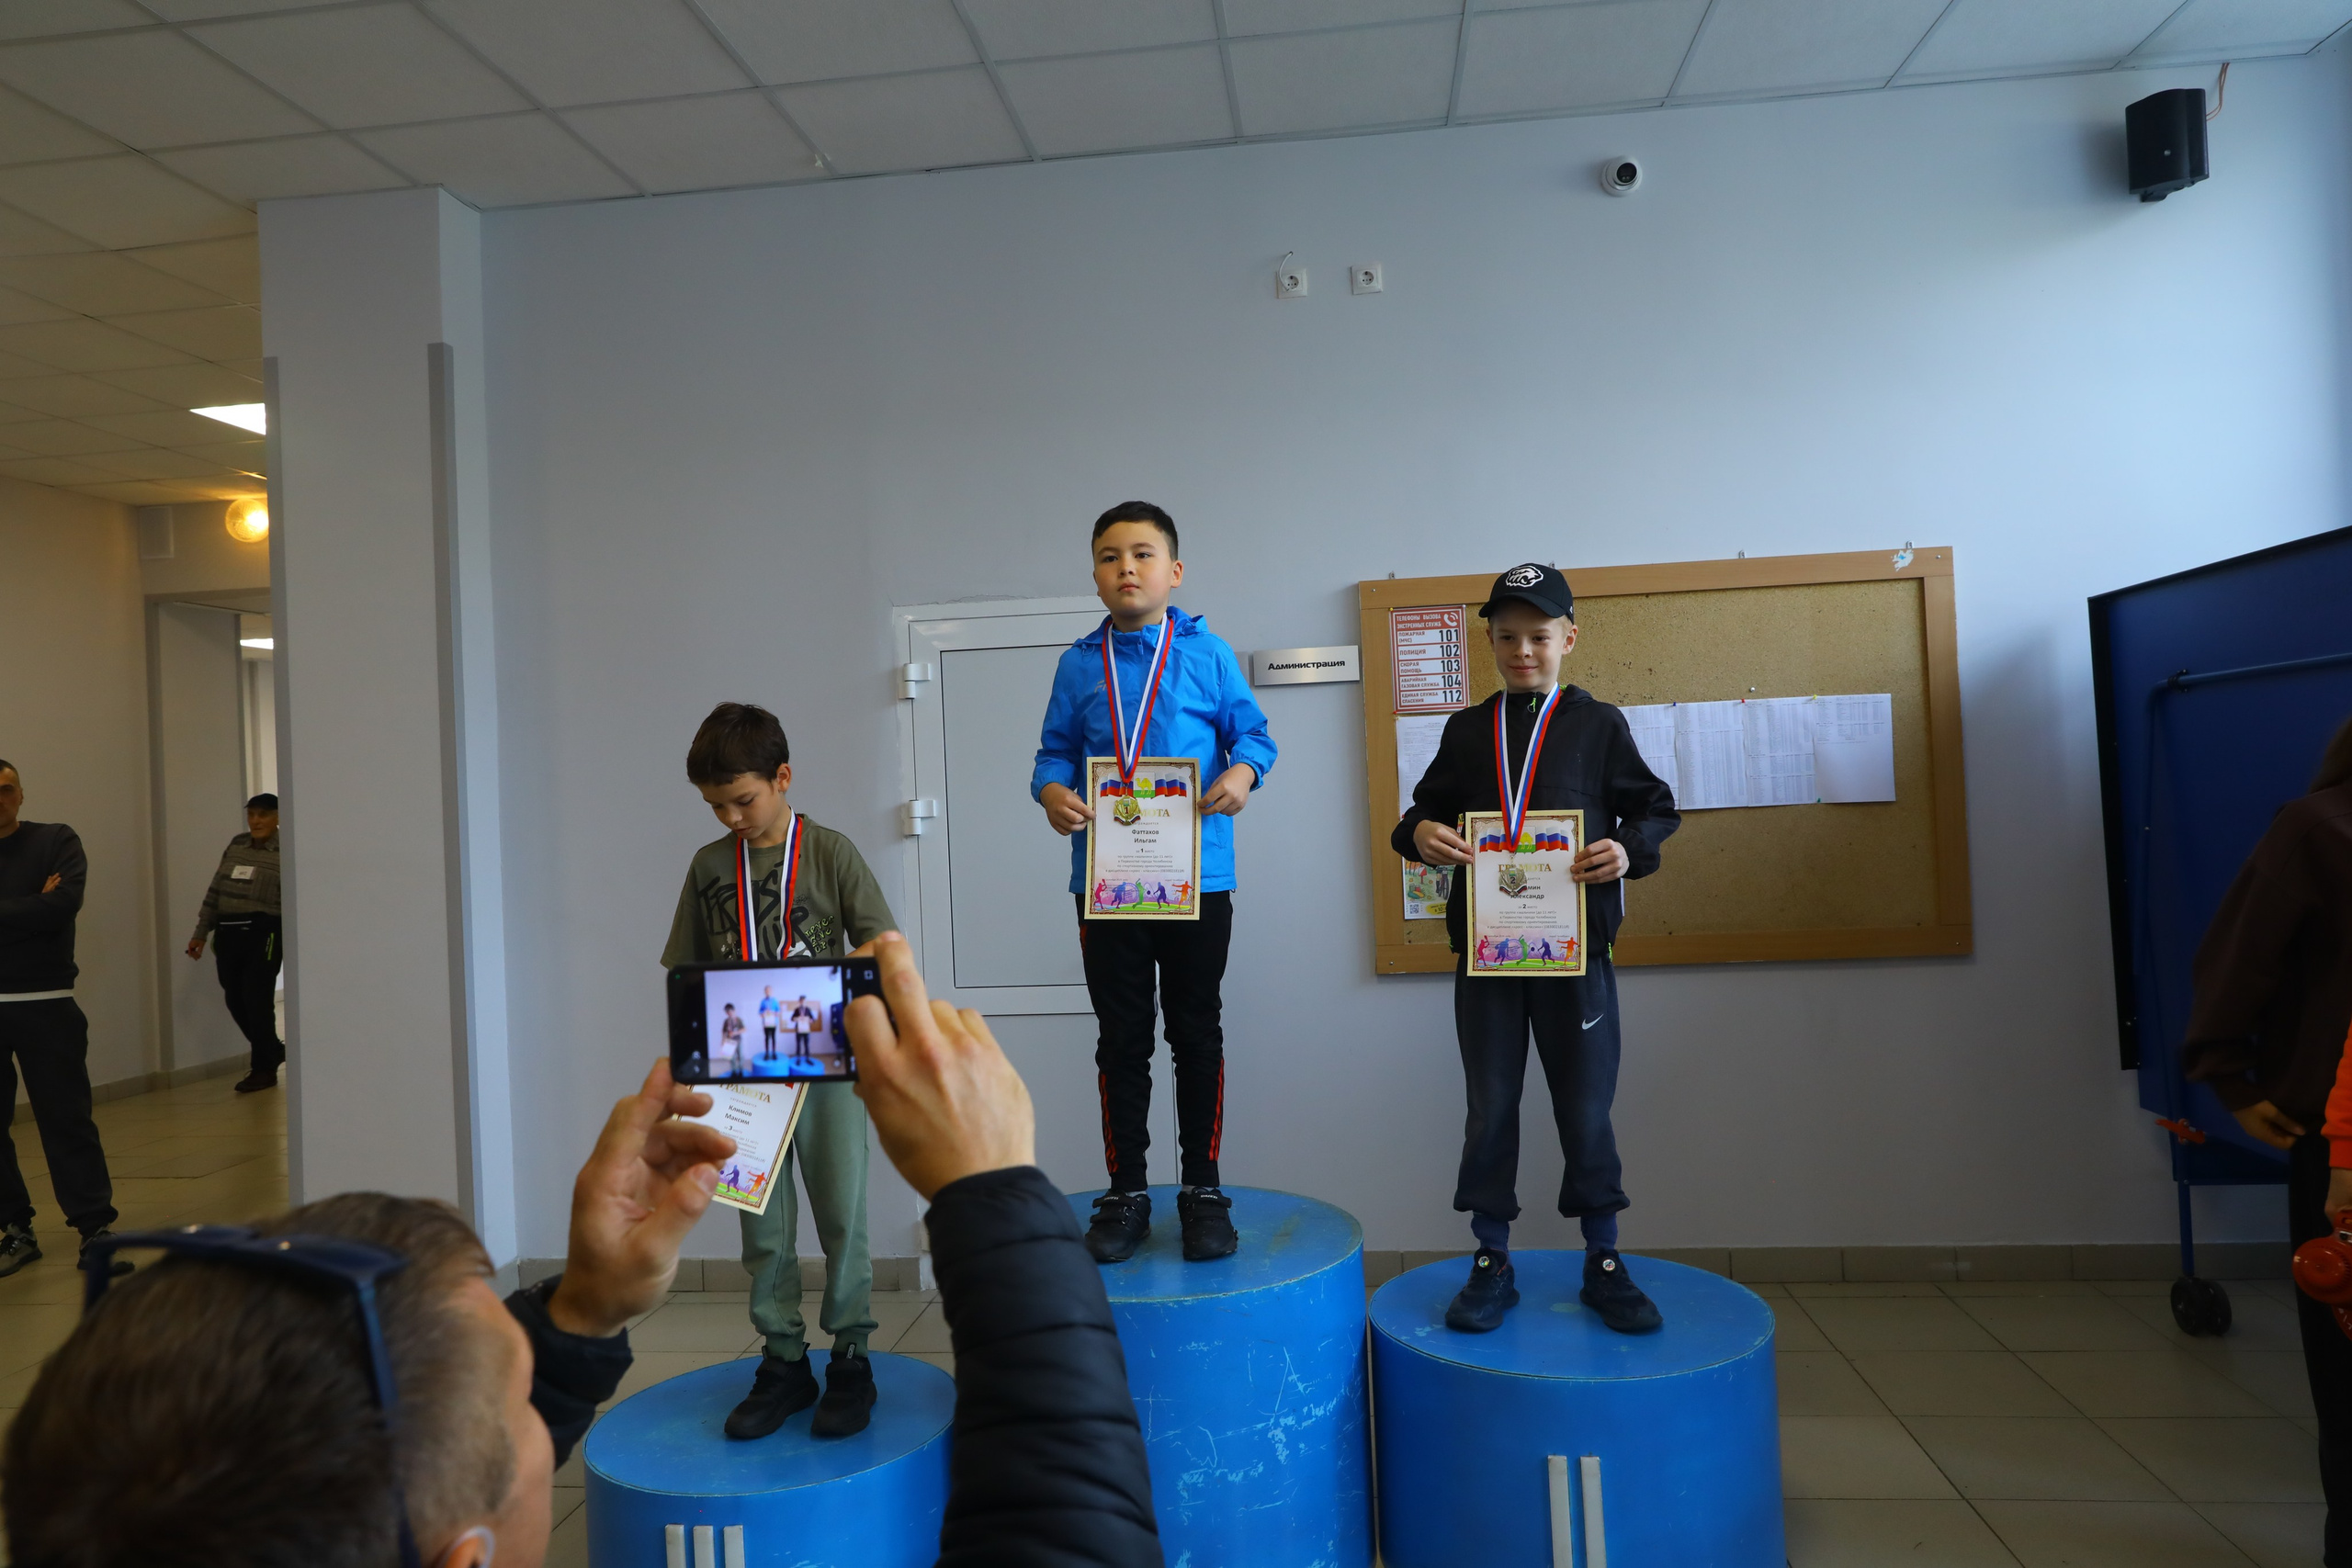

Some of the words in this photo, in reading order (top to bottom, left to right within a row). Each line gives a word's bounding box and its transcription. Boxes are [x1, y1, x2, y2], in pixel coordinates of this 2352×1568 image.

[1439, 628, 1459, 642] 101
[1440, 644, 1460, 658] 102
[1267, 660, 1346, 671] Администрация
[1441, 659, 1461, 672] 103
[1442, 674, 1462, 688] 104
[1442, 689, 1463, 703] 112
[1141, 808, 1170, 818] МОТА
[1498, 863, 1552, 872] ГРМОТА
[728, 1104, 752, 1117] Климов
[724, 1112, 751, 1125] Максим
